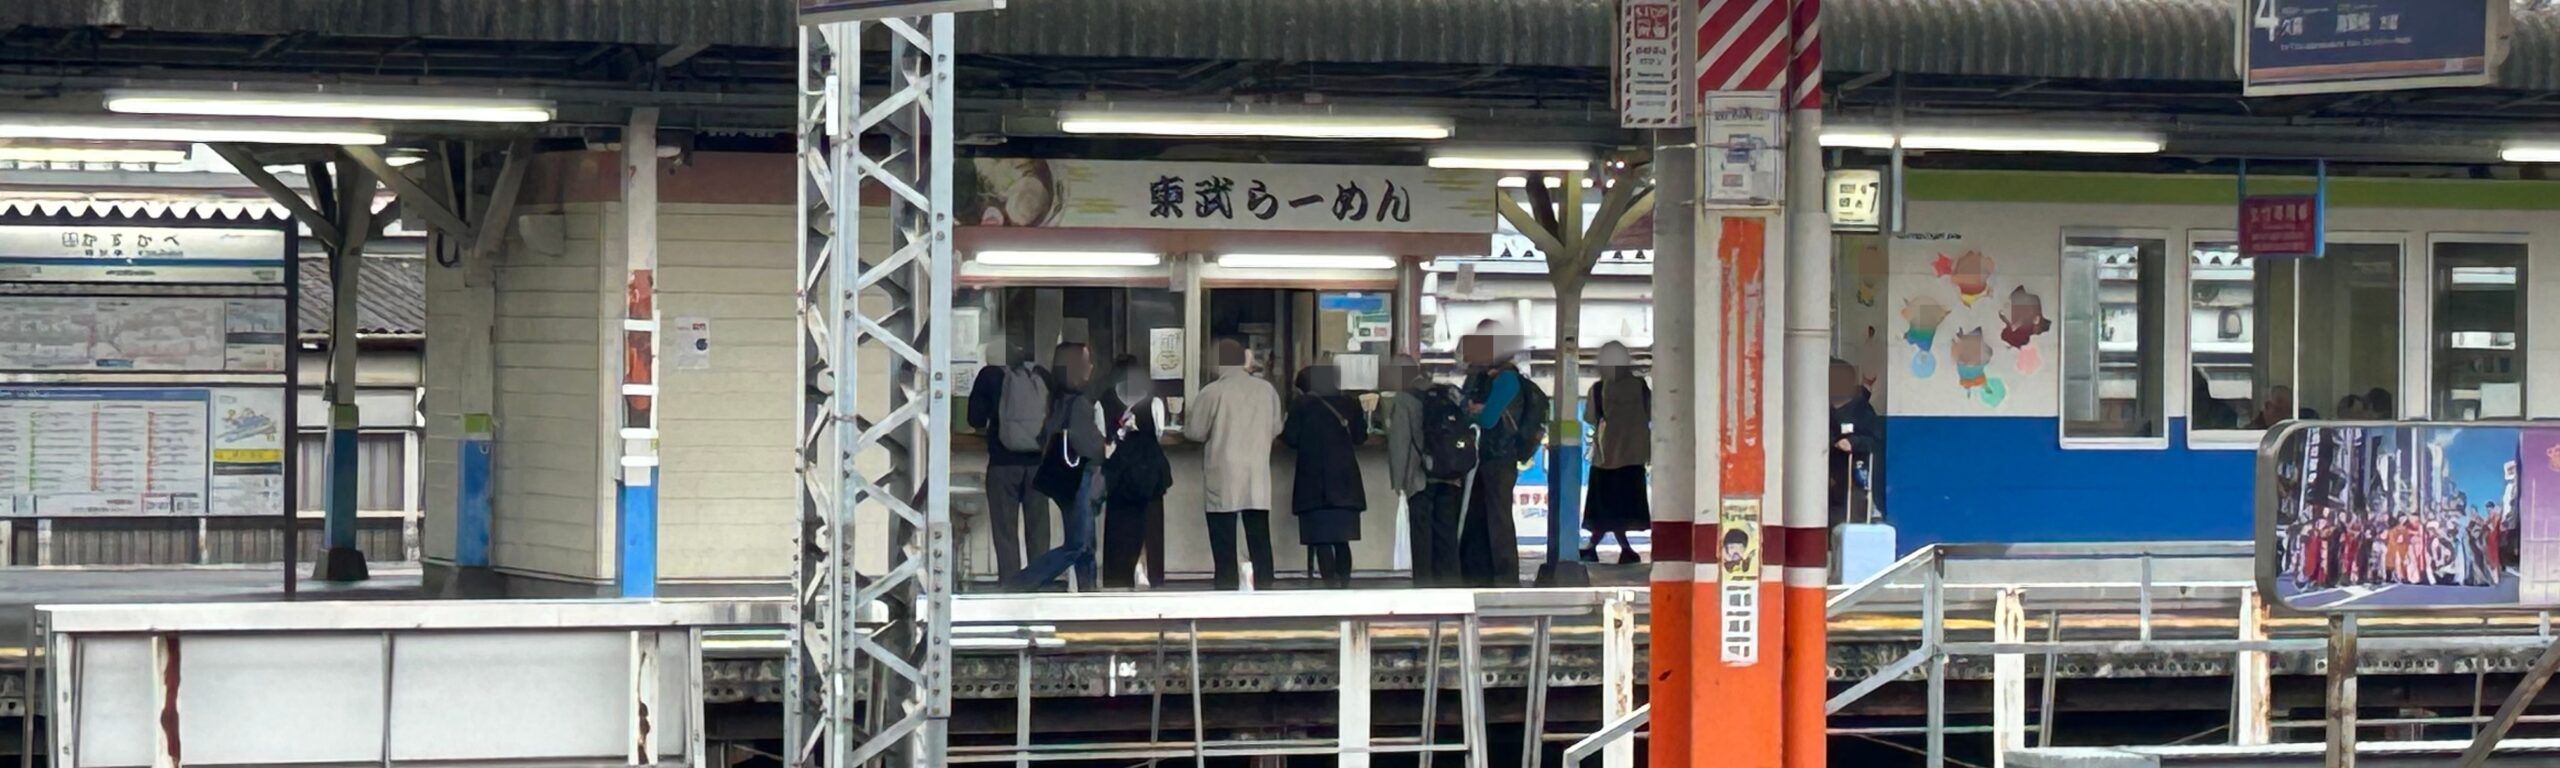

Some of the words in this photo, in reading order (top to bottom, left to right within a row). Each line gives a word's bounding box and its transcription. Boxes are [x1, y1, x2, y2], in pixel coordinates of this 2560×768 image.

[2254, 0, 2279, 42] 4
[1150, 175, 1410, 223] 東武らーめん
[1868, 181, 1879, 214] 7
